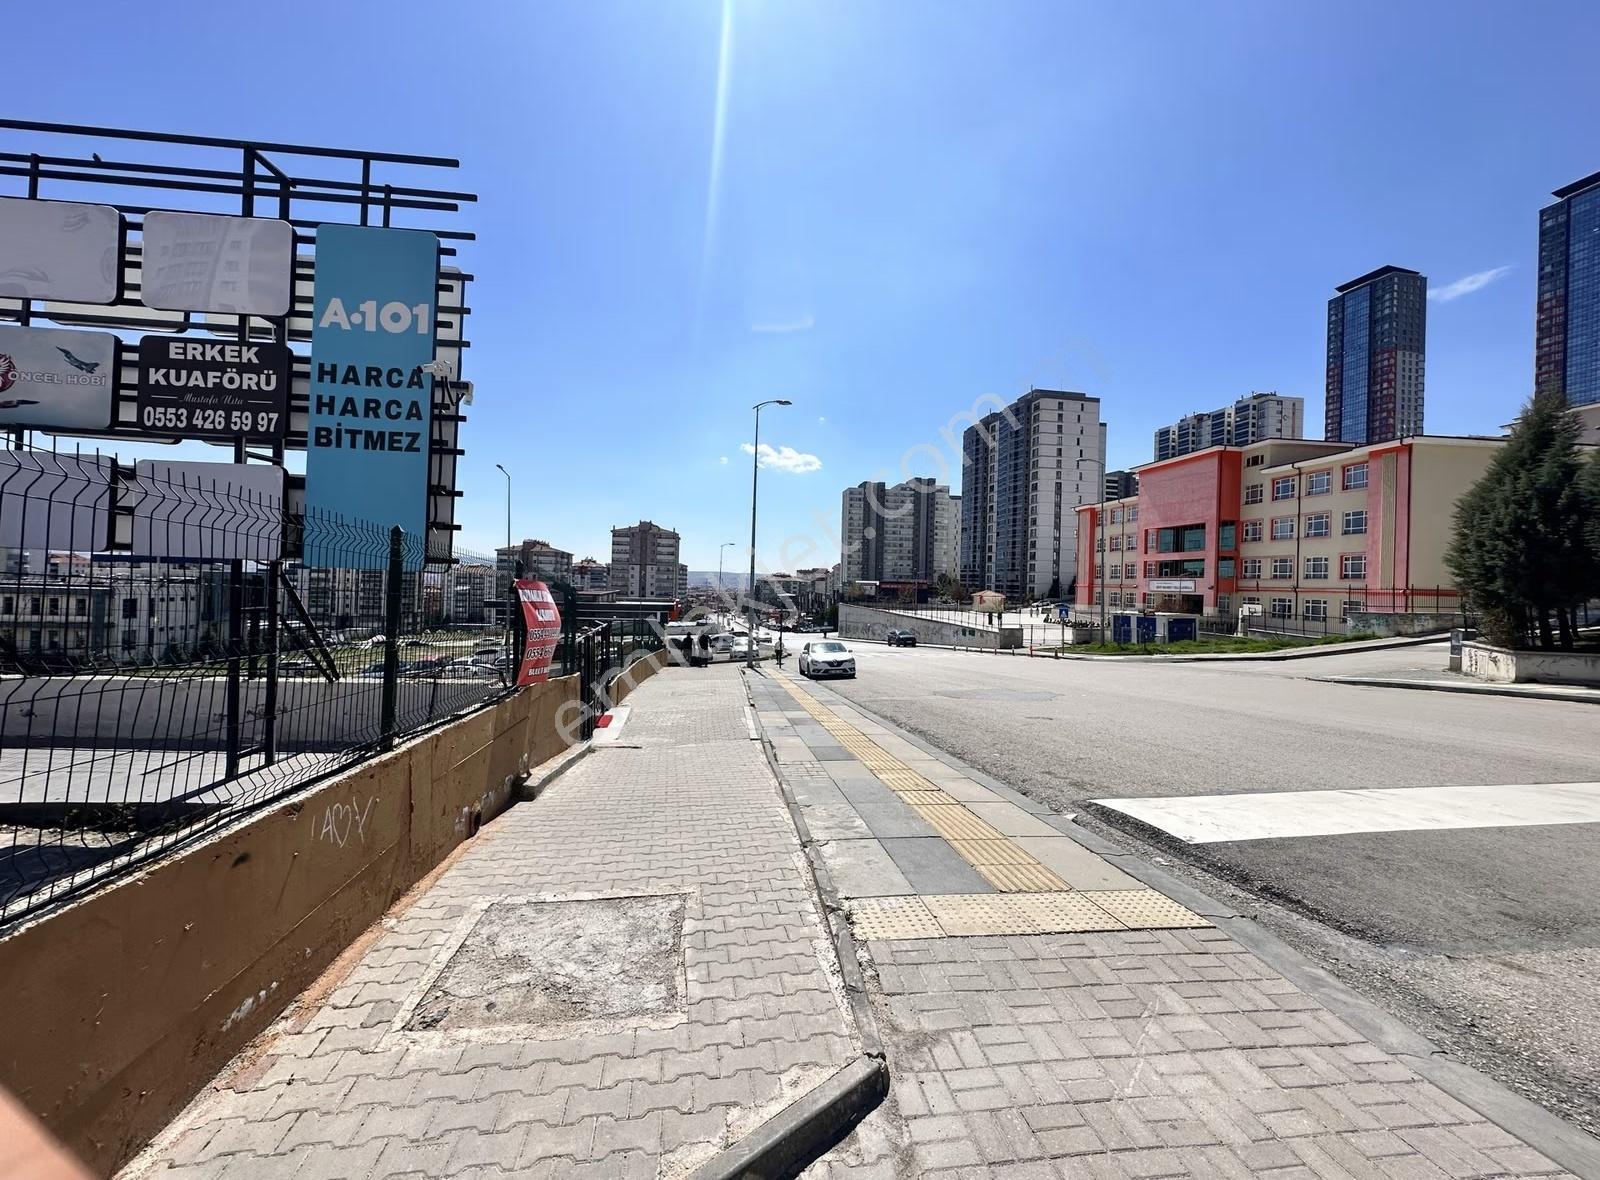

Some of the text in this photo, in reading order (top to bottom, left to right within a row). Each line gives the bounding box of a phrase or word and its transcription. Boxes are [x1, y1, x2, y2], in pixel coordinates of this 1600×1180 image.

[169, 342, 260, 364] ERKEK
[67, 373, 107, 386] HOBİ
[148, 367, 277, 391] KUAFÖRÜ
[317, 362, 425, 390] HARCA
[183, 393, 244, 406] Mustafa Usta
[315, 394, 424, 421] HARCA
[143, 406, 279, 433] 0553 426 59 97
[314, 422, 421, 453] BİTMEZ
